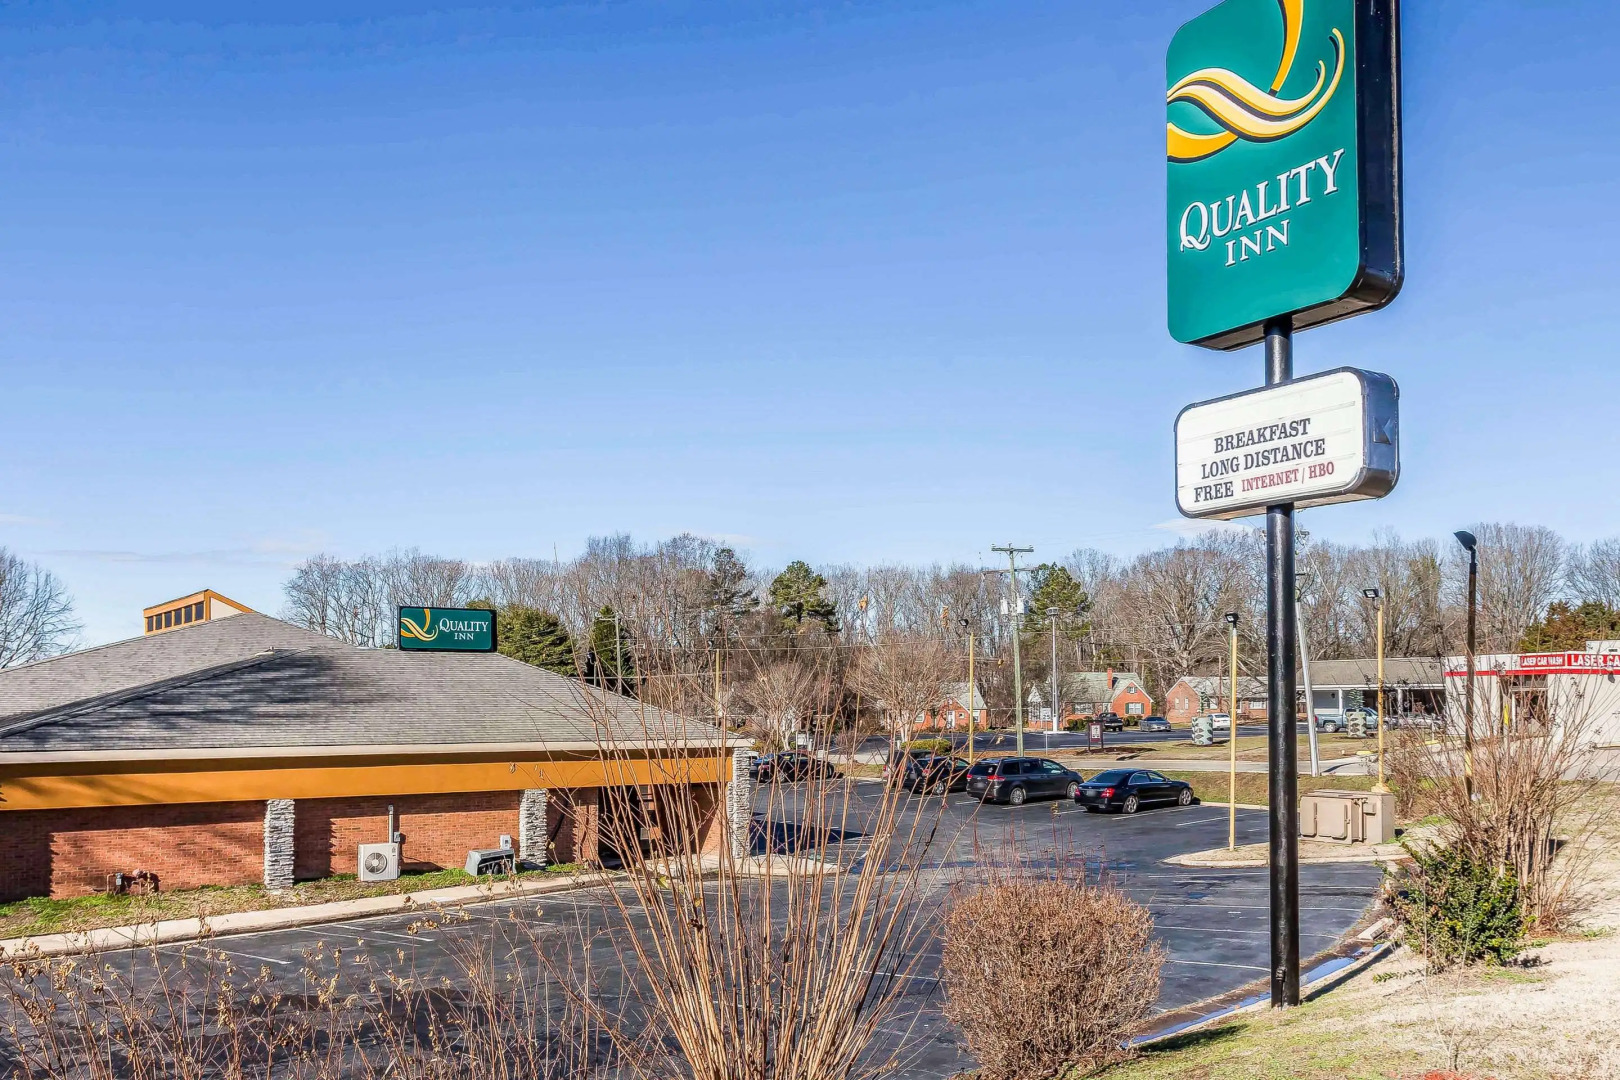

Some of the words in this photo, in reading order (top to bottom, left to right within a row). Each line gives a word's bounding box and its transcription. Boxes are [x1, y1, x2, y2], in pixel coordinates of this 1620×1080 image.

[1180, 148, 1345, 252] QUALITY
[1225, 219, 1290, 267] INN
[1214, 417, 1311, 454] BREAKFAST
[1201, 456, 1240, 480] LONG
[1243, 438, 1325, 471] DISTANCE
[1194, 481, 1234, 503] FREE
[1241, 468, 1300, 492] INTERNET
[1308, 461, 1335, 479] HBO
[439, 617, 489, 633] QUALITY
[454, 632, 474, 641] INN
[1537, 656, 1548, 665] CAR
[1571, 654, 1604, 667] LASER
